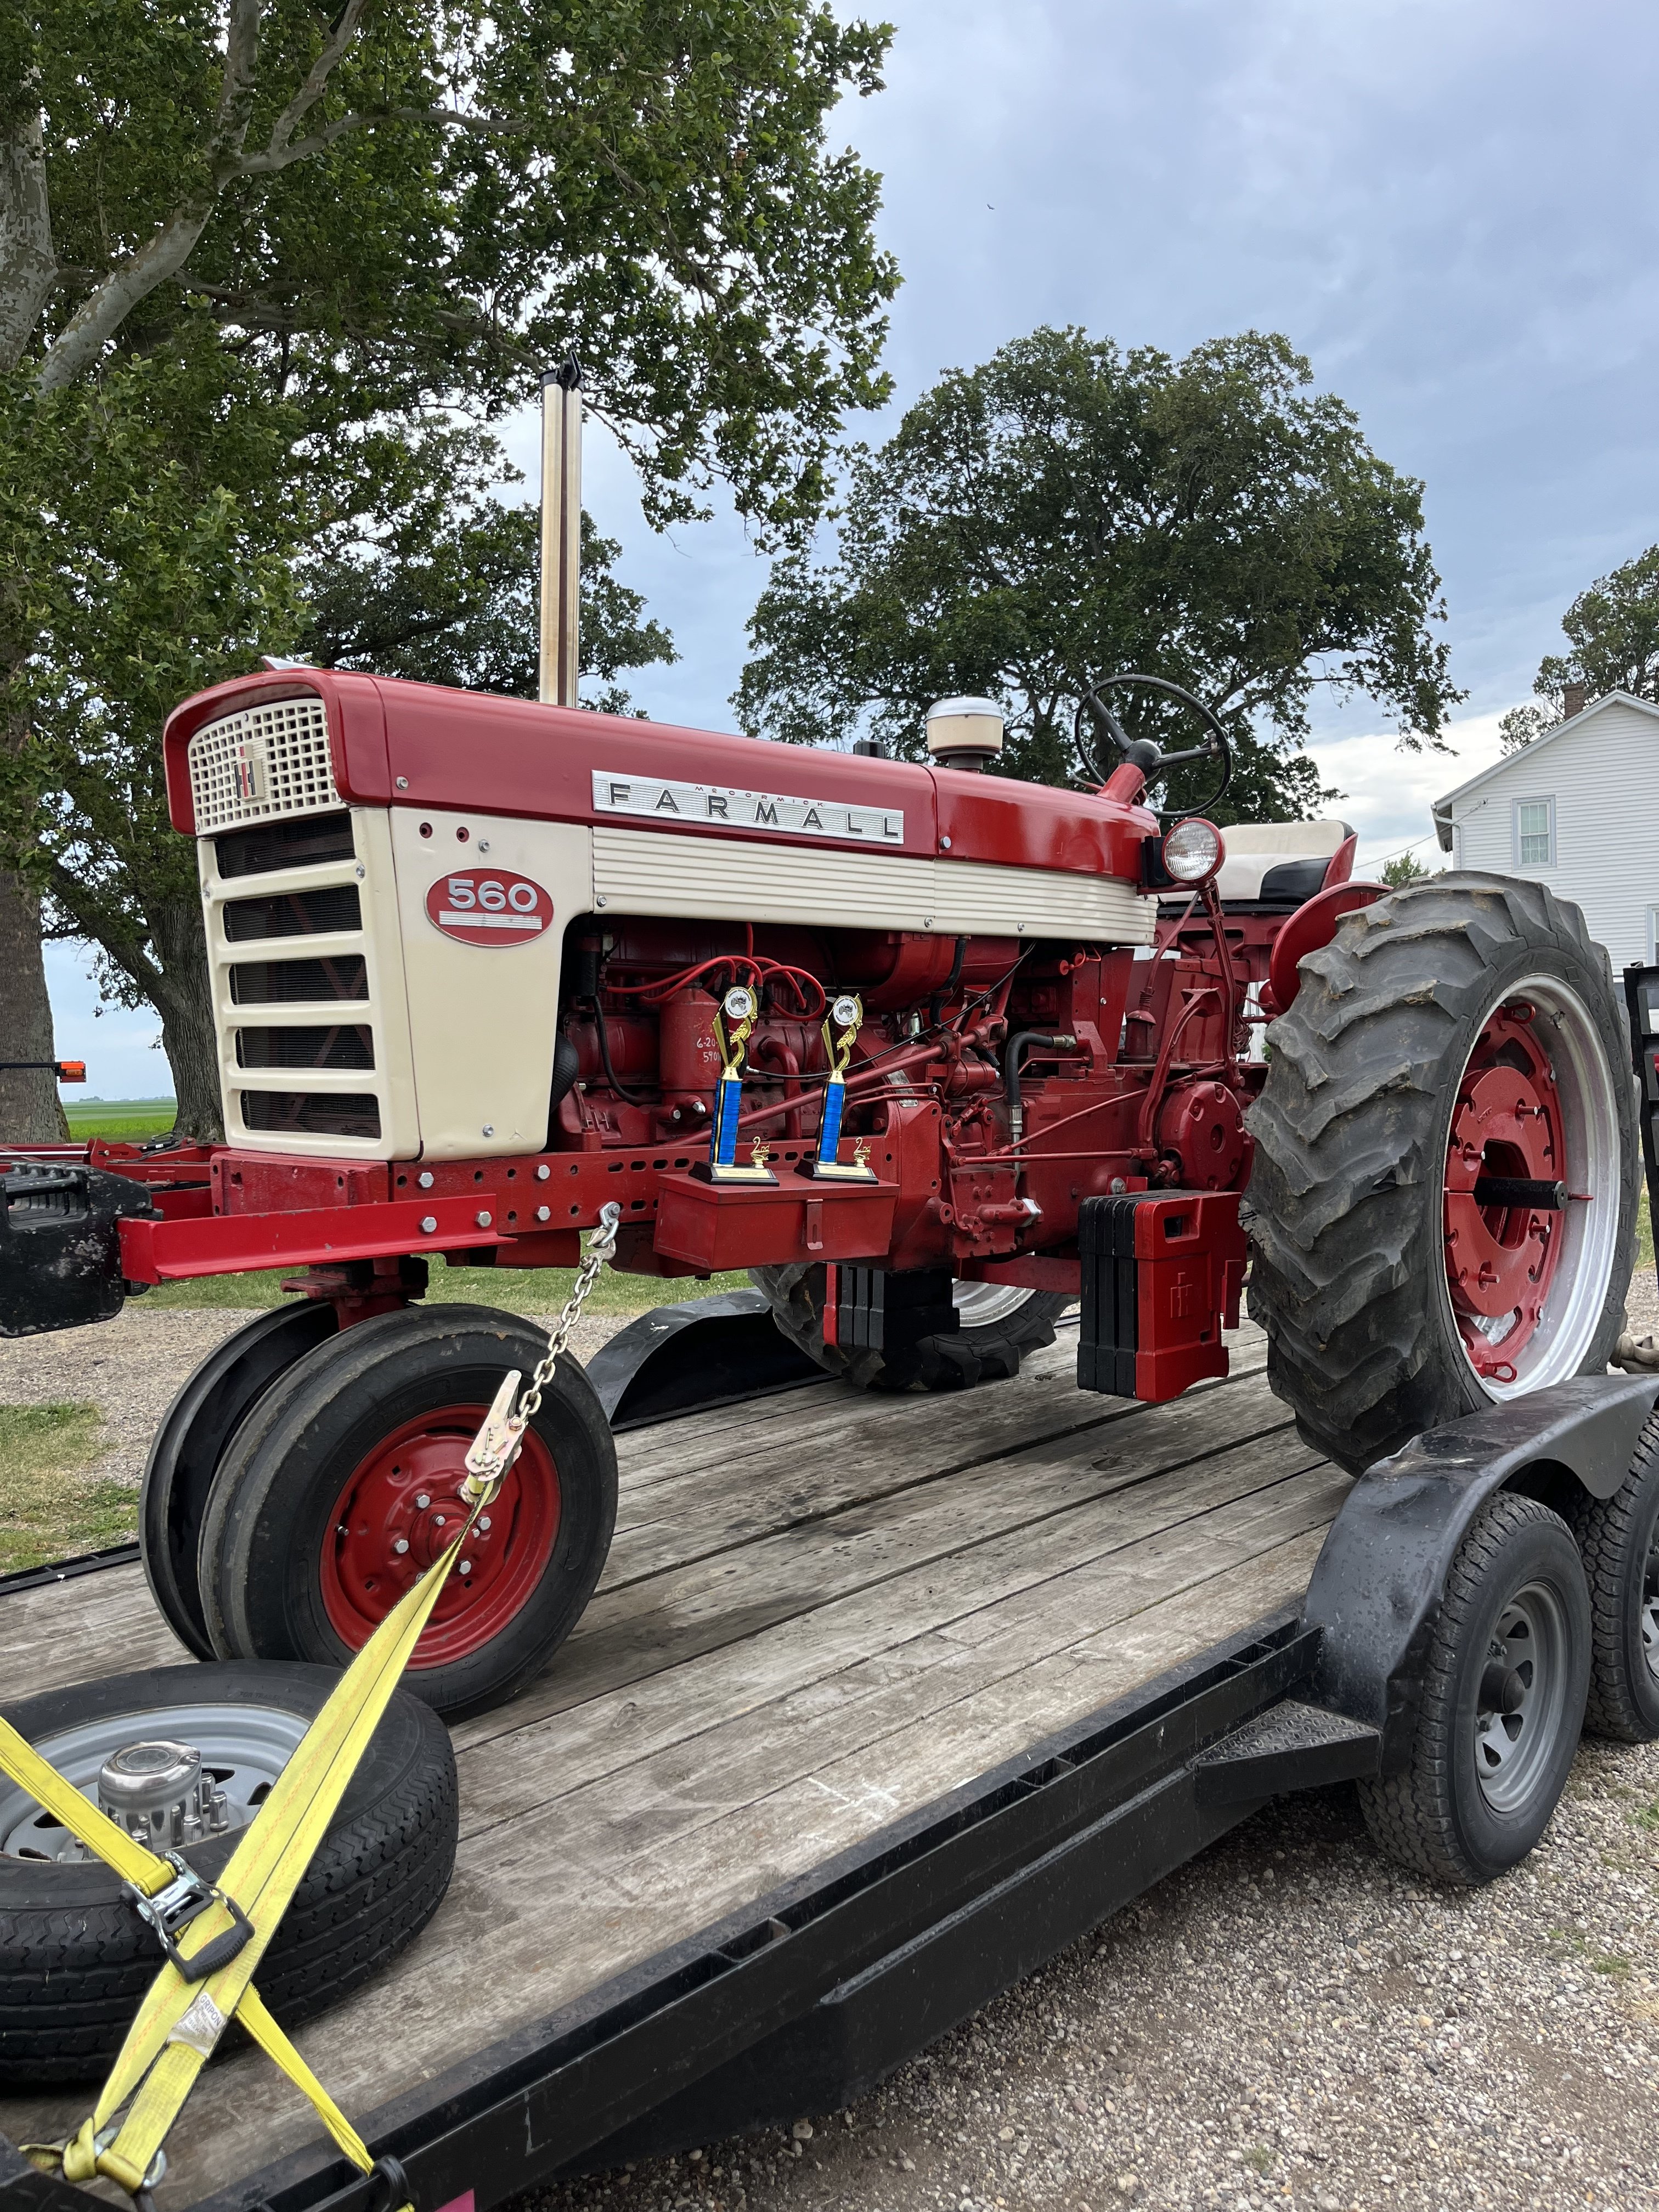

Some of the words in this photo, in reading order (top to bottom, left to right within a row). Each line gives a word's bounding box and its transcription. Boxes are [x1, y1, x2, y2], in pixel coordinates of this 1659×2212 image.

[608, 782, 899, 838] FARMALL
[448, 878, 538, 913] 560
[200, 1995, 222, 2027] GRIPON
